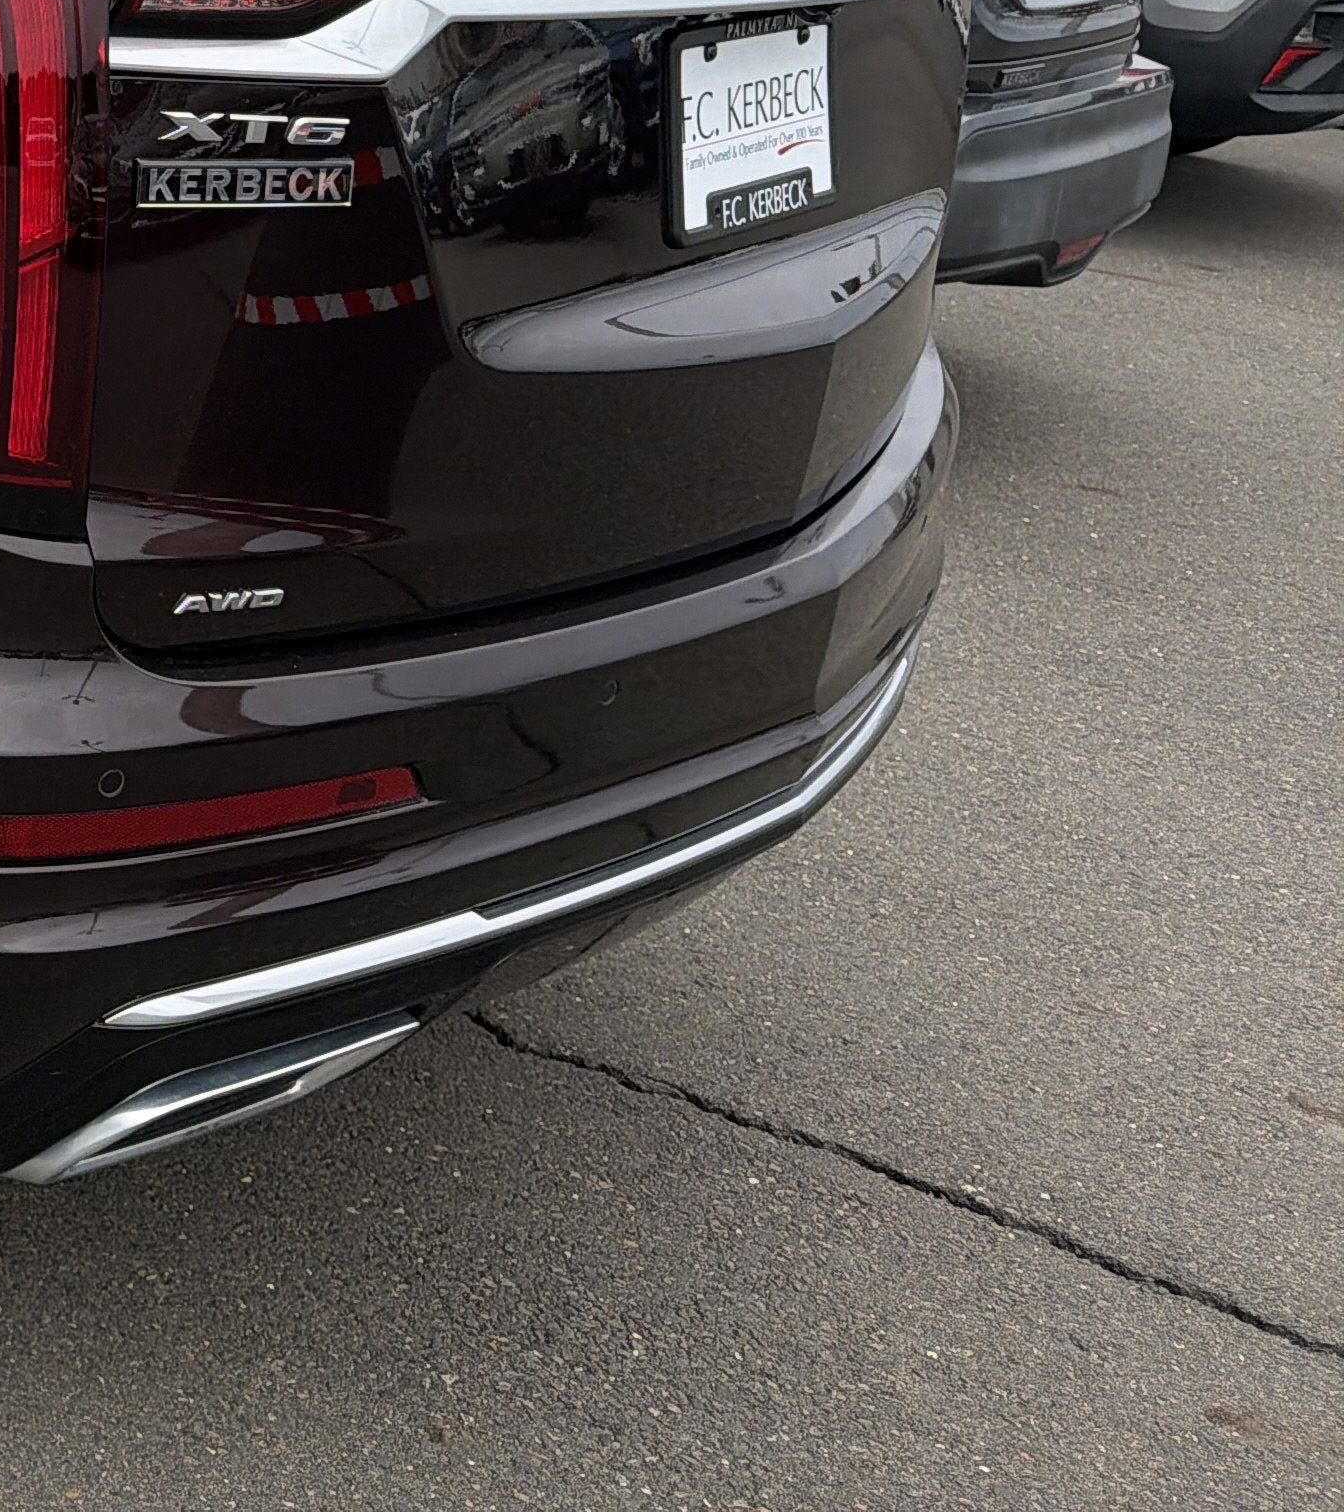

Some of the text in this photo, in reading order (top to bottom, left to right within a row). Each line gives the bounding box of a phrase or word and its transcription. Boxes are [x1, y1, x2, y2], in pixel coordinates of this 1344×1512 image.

[727, 66, 824, 132] KERBECK
[158, 111, 350, 145] XT6
[706, 145, 732, 166] Owned
[738, 136, 768, 159] Operated
[779, 130, 794, 145] Over
[148, 168, 343, 202] KERBECK
[722, 178, 809, 229] F.C. KERBECK
[172, 588, 285, 615] AWD
